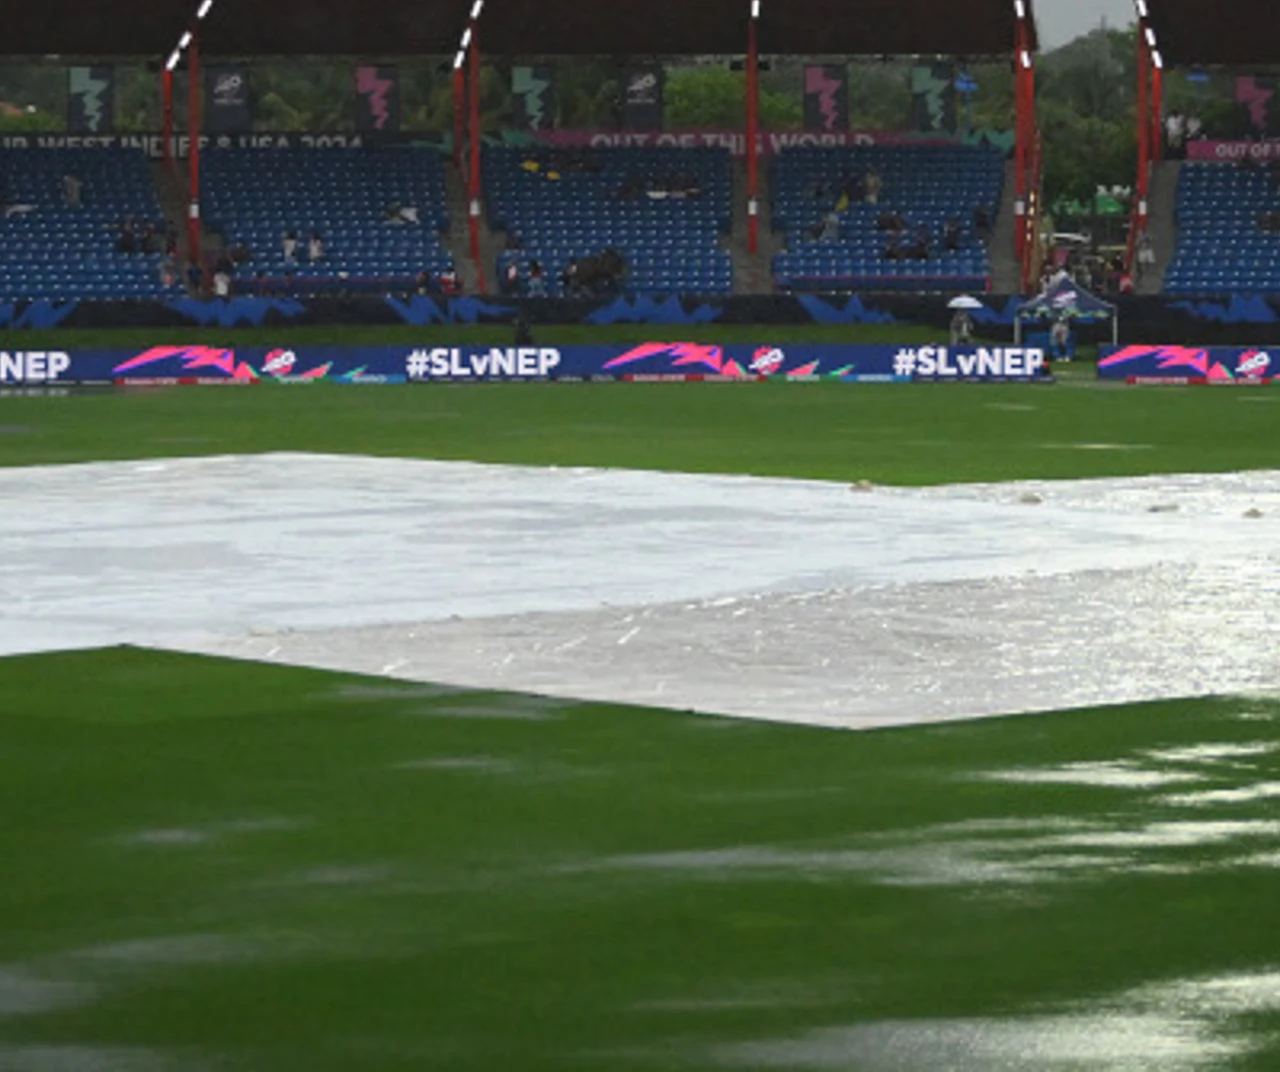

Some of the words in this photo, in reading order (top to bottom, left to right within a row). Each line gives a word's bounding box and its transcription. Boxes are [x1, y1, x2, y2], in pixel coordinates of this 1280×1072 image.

[1215, 142, 1247, 158] OUT
[1250, 142, 1271, 158] OF
[406, 347, 561, 378] #SLvNEP
[894, 345, 1045, 377] #SLvNEP
